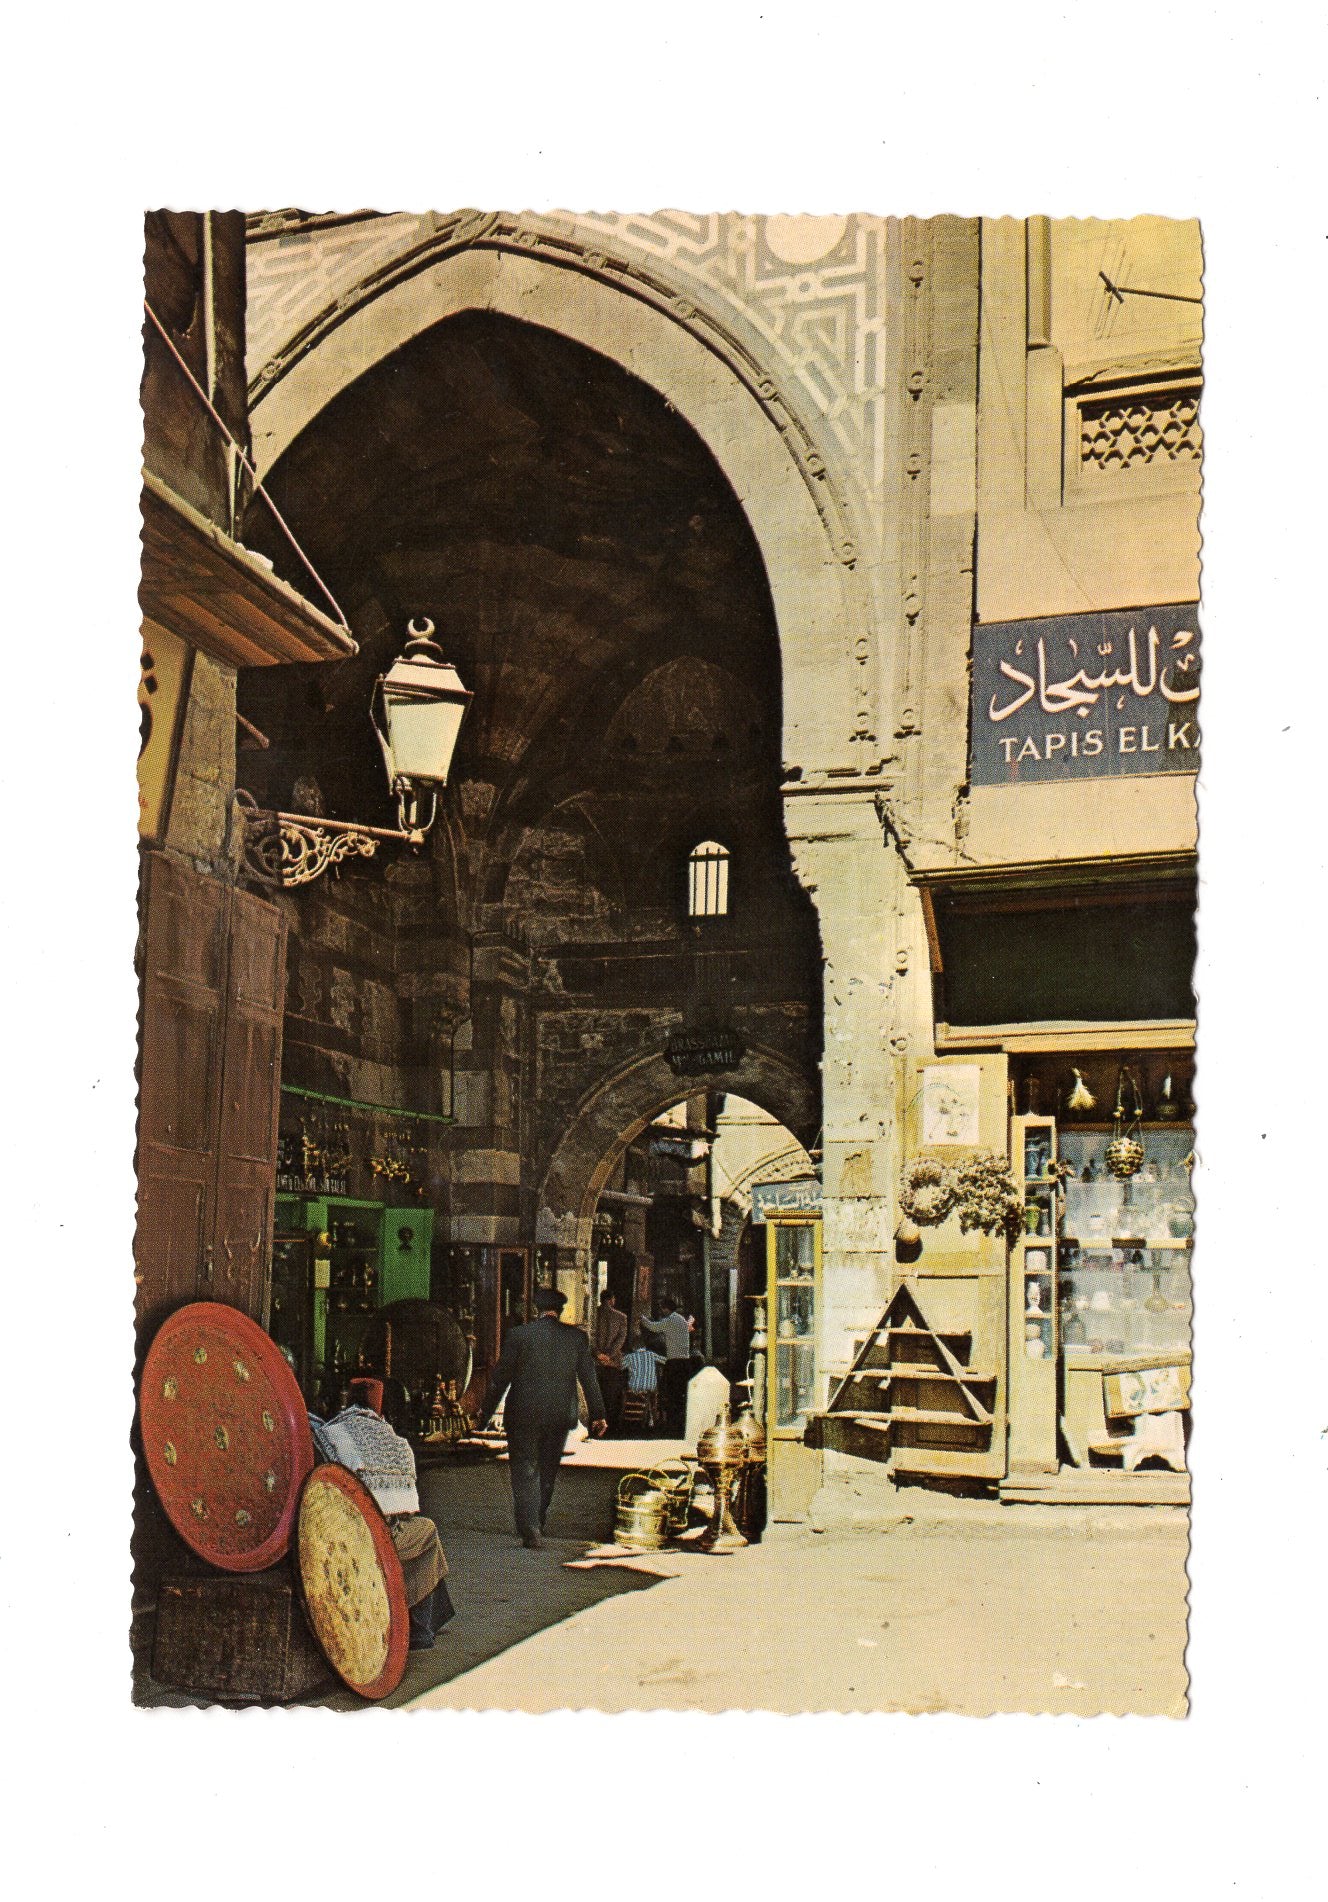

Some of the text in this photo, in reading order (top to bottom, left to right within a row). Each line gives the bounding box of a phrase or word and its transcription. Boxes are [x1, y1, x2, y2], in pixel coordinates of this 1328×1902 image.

[998, 721, 1200, 763] TAPIS EL K
